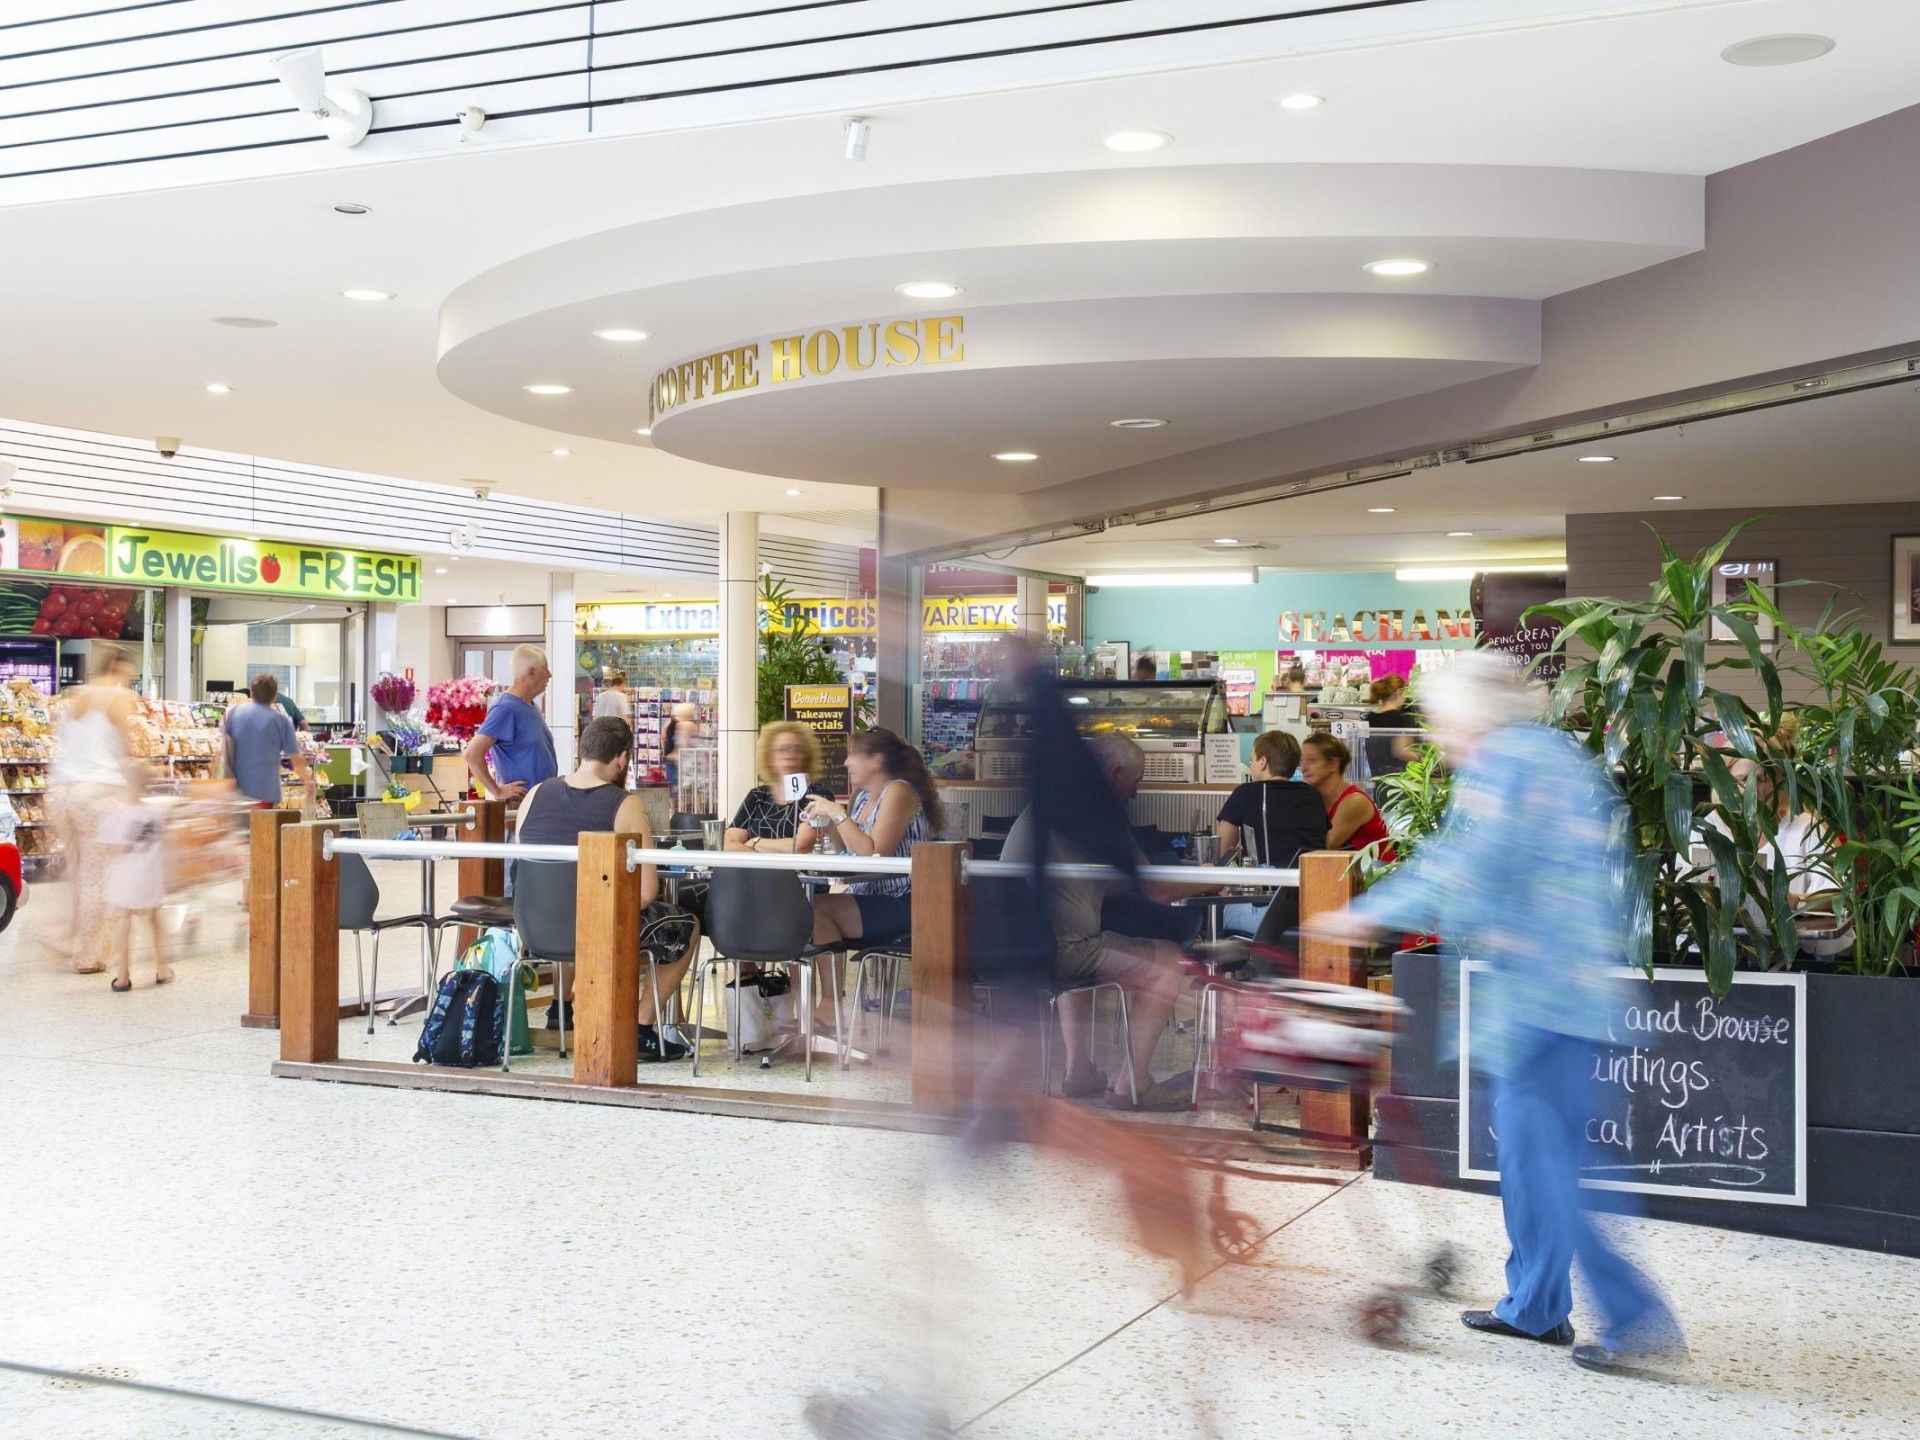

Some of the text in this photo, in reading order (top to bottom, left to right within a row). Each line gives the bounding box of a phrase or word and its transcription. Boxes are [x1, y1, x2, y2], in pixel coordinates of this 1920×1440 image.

[655, 343, 759, 415] COFFEE
[769, 315, 965, 385] HOUSE
[117, 535, 417, 597] Jewells FRESH
[1494, 642, 1548, 655] MAKES YOU
[1506, 653, 1531, 667] EIRD
[795, 710, 844, 720] Takeaway
[1336, 723, 1343, 735] 3
[791, 776, 800, 793] 9
[1624, 1000, 1687, 1034] and
[1691, 996, 1790, 1045] Browse
[1591, 1046, 1710, 1109] intings
[1585, 1102, 1770, 1160] cal Artists
